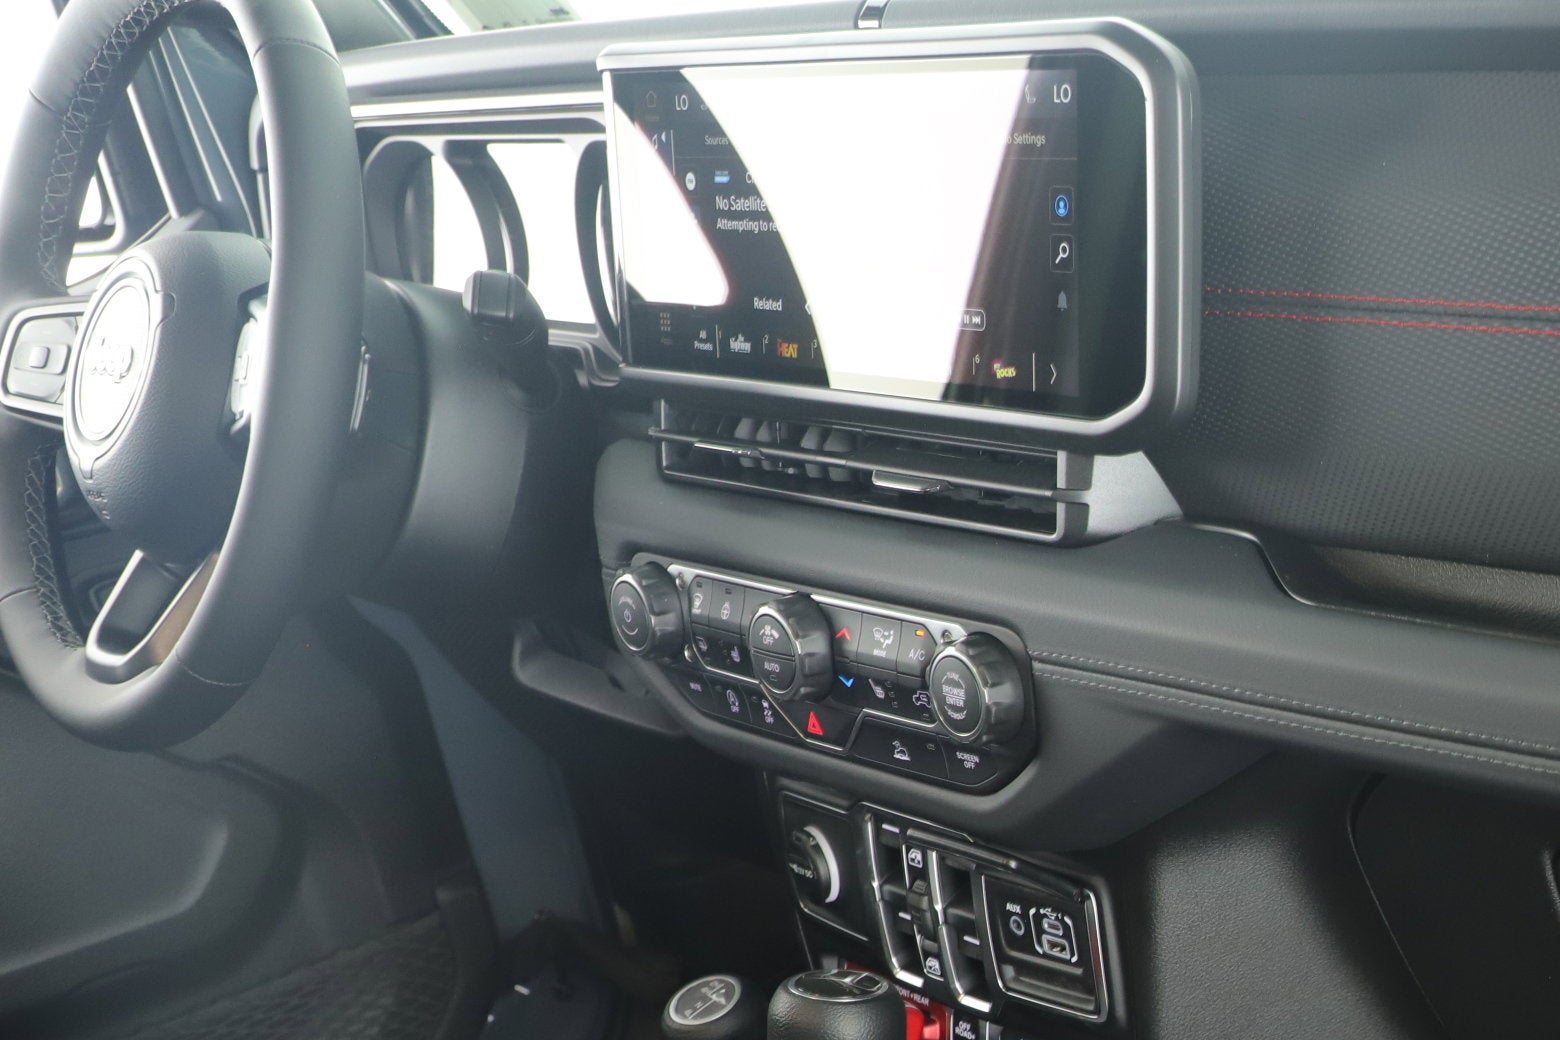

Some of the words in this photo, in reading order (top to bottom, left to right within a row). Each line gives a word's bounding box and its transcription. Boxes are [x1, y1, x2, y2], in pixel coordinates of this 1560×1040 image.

[1053, 83, 1071, 103] LO
[675, 94, 688, 111] LO
[704, 135, 729, 145] Sources
[1013, 133, 1046, 147] Settings
[715, 195, 729, 211] No
[730, 195, 766, 212] Satellite
[716, 217, 758, 234] Attempting
[760, 219, 768, 232] to
[753, 296, 782, 312] Related
[694, 340, 713, 351] Presets
[765, 335, 769, 344] 2
[777, 341, 799, 358] HEAT
[975, 354, 980, 364] 6
[996, 366, 1016, 379] ROCKS
[762, 636, 774, 646] OFF
[908, 648, 926, 661] A/C
[764, 662, 780, 673] AUTO
[942, 685, 965, 698] BROWSE
[945, 697, 964, 707] ENTER
[956, 751, 980, 763] SCREEN
[963, 761, 976, 770] OFF
[1006, 902, 1022, 914] AUX
[958, 1021, 971, 1031] OFF
